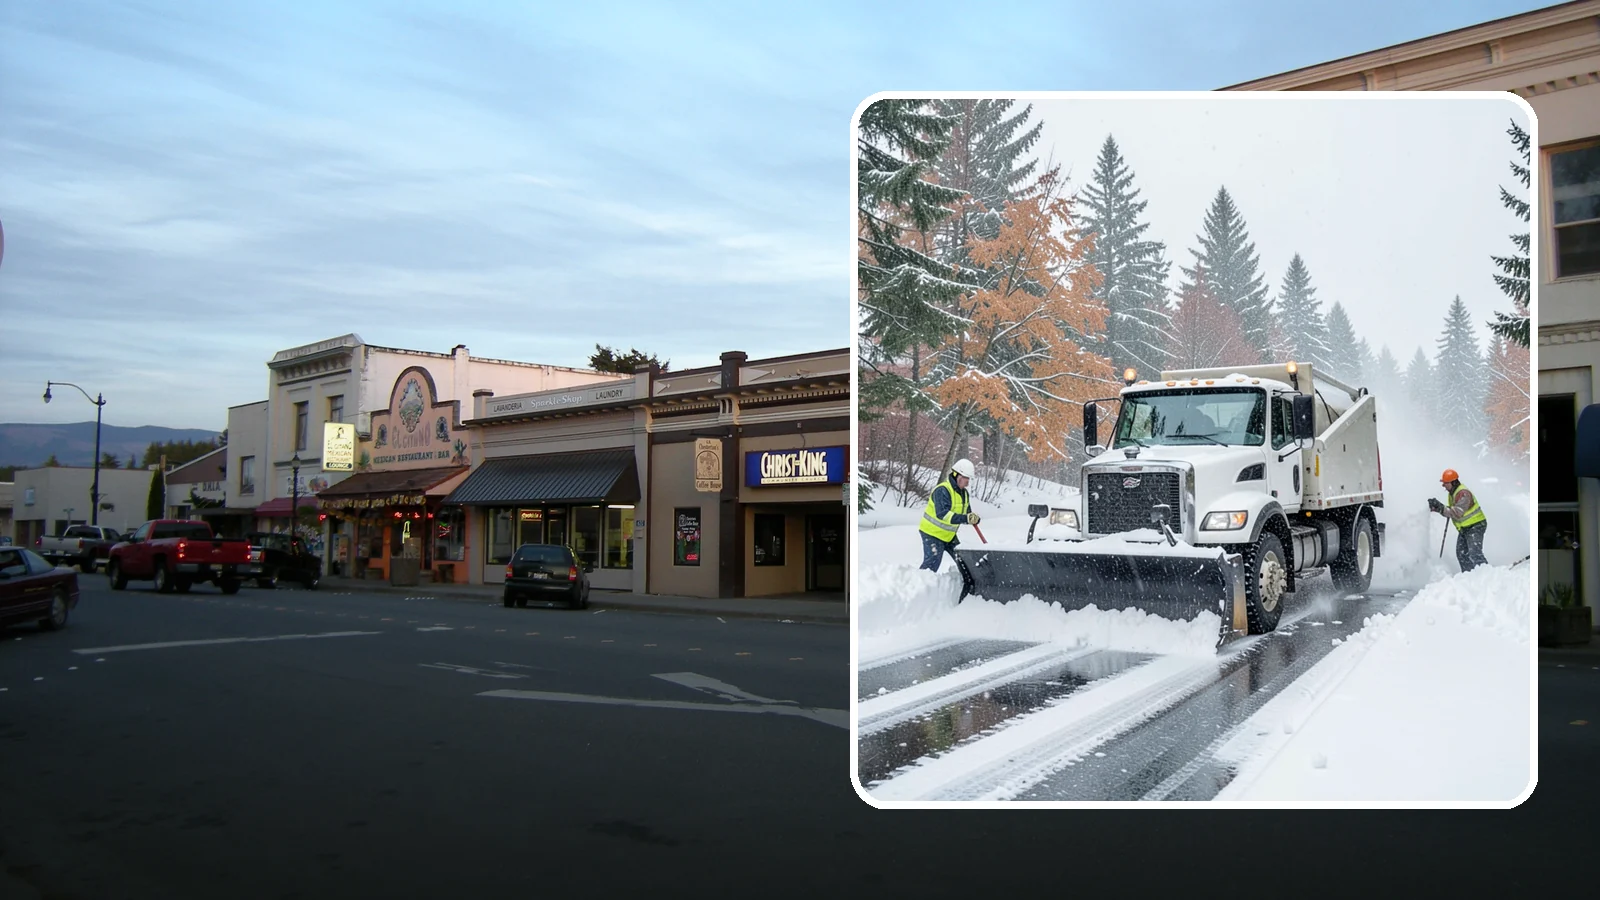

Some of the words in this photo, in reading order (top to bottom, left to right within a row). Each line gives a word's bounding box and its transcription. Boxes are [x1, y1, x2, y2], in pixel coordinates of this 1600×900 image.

[530, 399, 561, 408] Sparkle
[561, 394, 582, 404] Shop
[595, 389, 623, 400] LAUNDRY
[493, 402, 522, 412] LAVANDERIA
[373, 455, 396, 464] MEXICAN
[397, 451, 433, 462] RESTAURANT
[437, 450, 450, 458] BAR
[761, 452, 797, 478] CHRIST
[799, 450, 827, 476] KING
